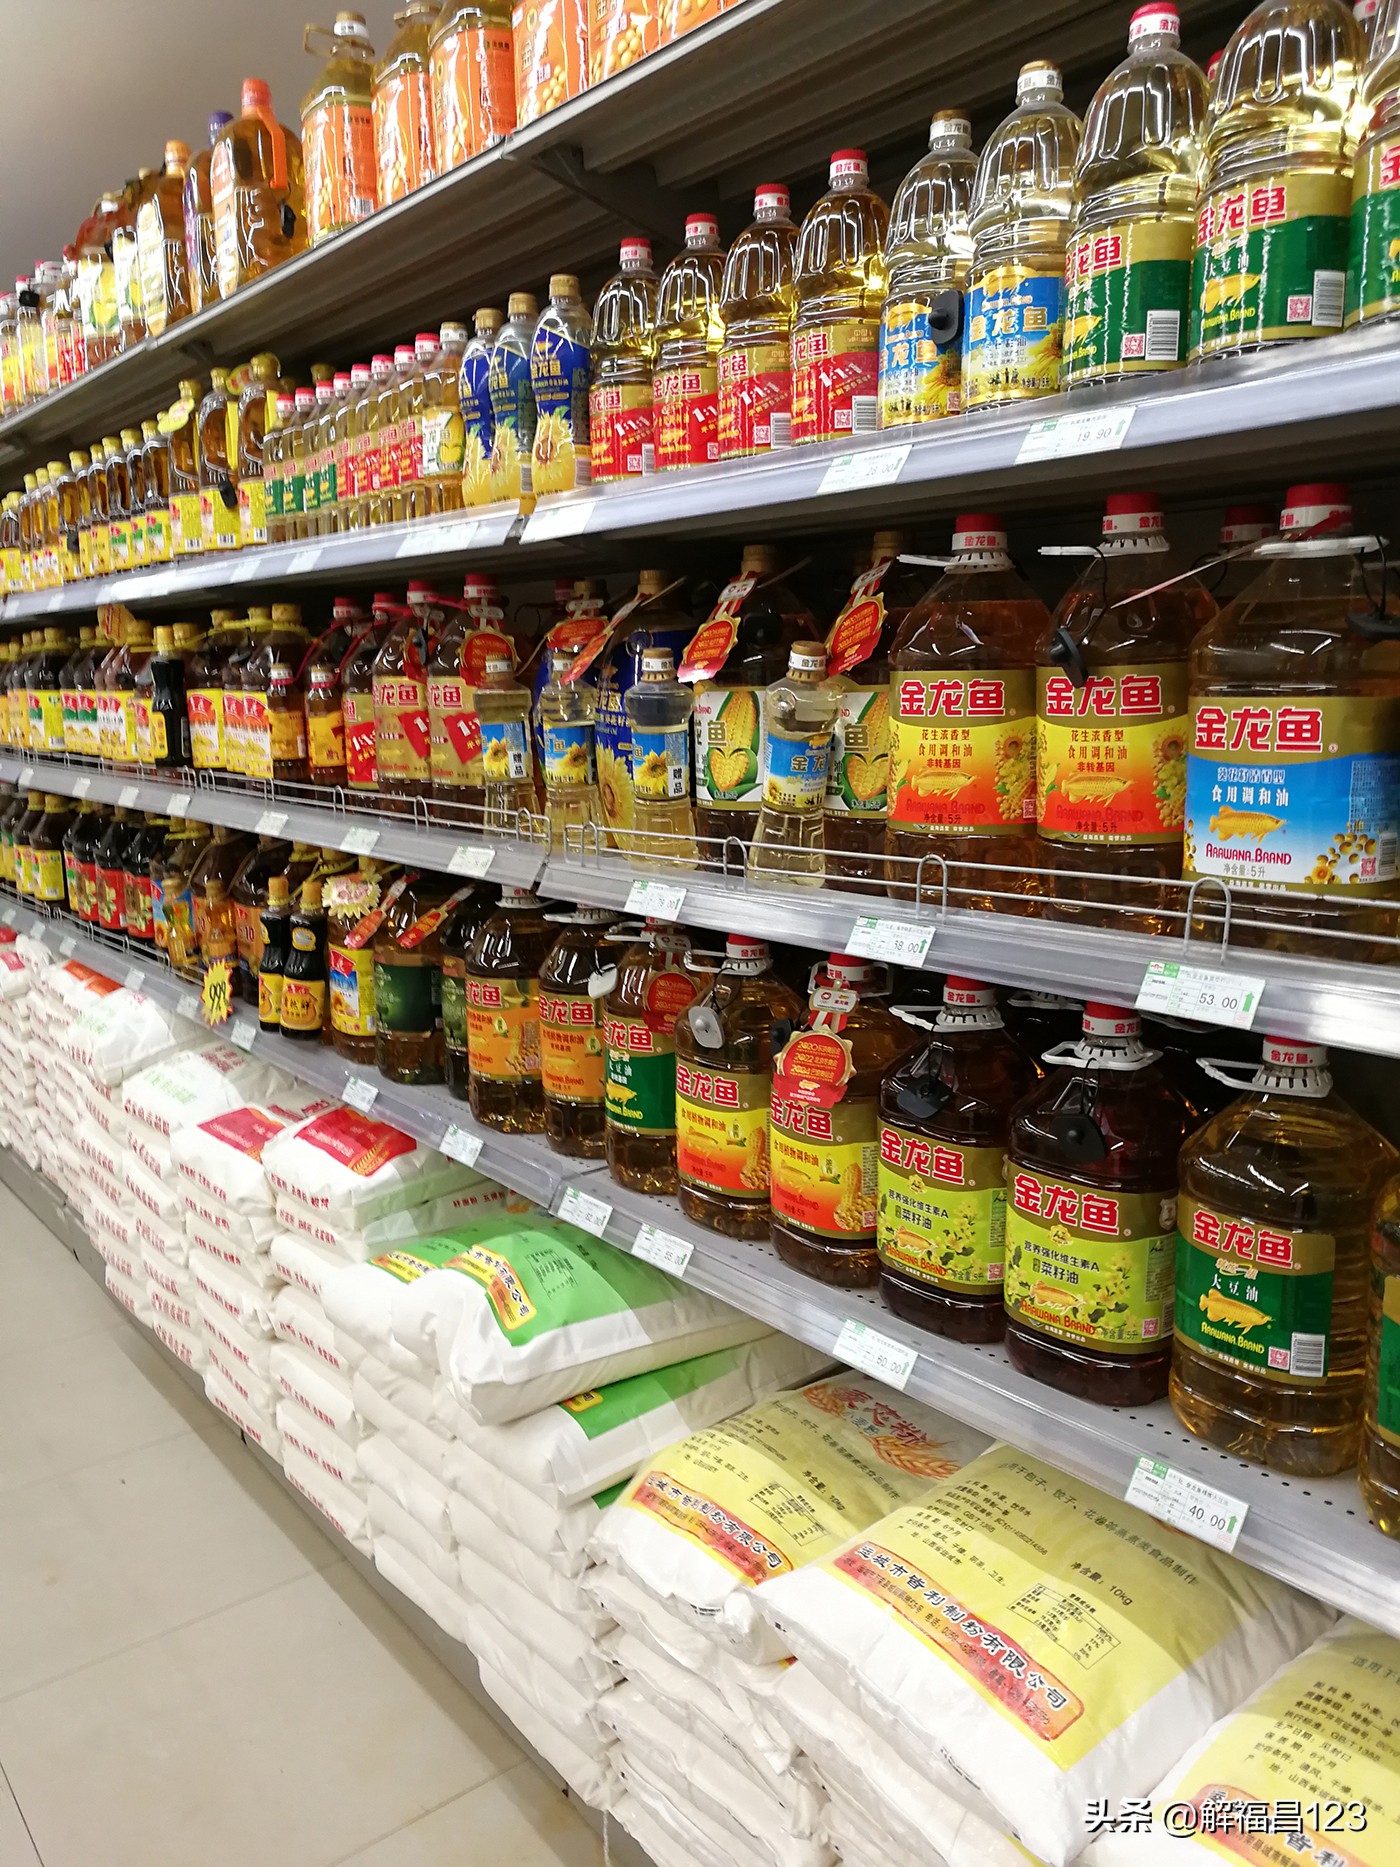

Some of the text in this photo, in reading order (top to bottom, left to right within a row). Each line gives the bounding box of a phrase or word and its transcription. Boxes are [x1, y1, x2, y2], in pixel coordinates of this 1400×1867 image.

[1197, 186, 1286, 247] 金龙鱼
[970, 306, 1047, 342] 金龙鱼
[819, 362, 863, 388] 1:1:1
[964, 535, 998, 547] 金龙鱼
[900, 678, 1005, 717] 金龙鱼
[1045, 674, 1163, 717] 金龙鱼
[921, 728, 971, 742] 花生浓香型
[1071, 729, 1124, 744] 花生浓香型
[1195, 706, 1323, 753] 金龙鱼
[918, 743, 973, 758] 食用调和油
[1068, 745, 1128, 761] 食用调和油
[926, 758, 961, 770] 非转基因
[1077, 761, 1115, 773] 非转基因
[1217, 766, 1285, 785] 葵花籽清香型
[1211, 784, 1289, 808] 食用调和油
[1206, 842, 1292, 866] ARAWANA BRAND
[1199, 992, 1238, 1010] 53.00
[1270, 1049, 1309, 1064] 金龙鱼
[676, 1063, 740, 1109] 金龙鱼
[880, 1127, 965, 1185] 金龙鱼
[888, 1189, 949, 1219] 营养强化维生素A
[1014, 1173, 1121, 1237] 金龙鱼
[902, 1207, 932, 1230] 菜籽油
[1193, 1209, 1294, 1268] 金龙鱼
[920, 1256, 947, 1277] BRAND
[1023, 1240, 1100, 1272] 营养强化维生素A
[1041, 1261, 1080, 1286] 菜籽油
[1211, 1272, 1259, 1304] 大豆油
[1063, 1314, 1096, 1336] BRAND
[1201, 1324, 1265, 1355] ARAWANA BRAND
[1189, 1503, 1226, 1531] 40.00
[1108, 1585, 1134, 1607] 10kg
[857, 1545, 1069, 1710] 运城市皆利制粉有限公司
